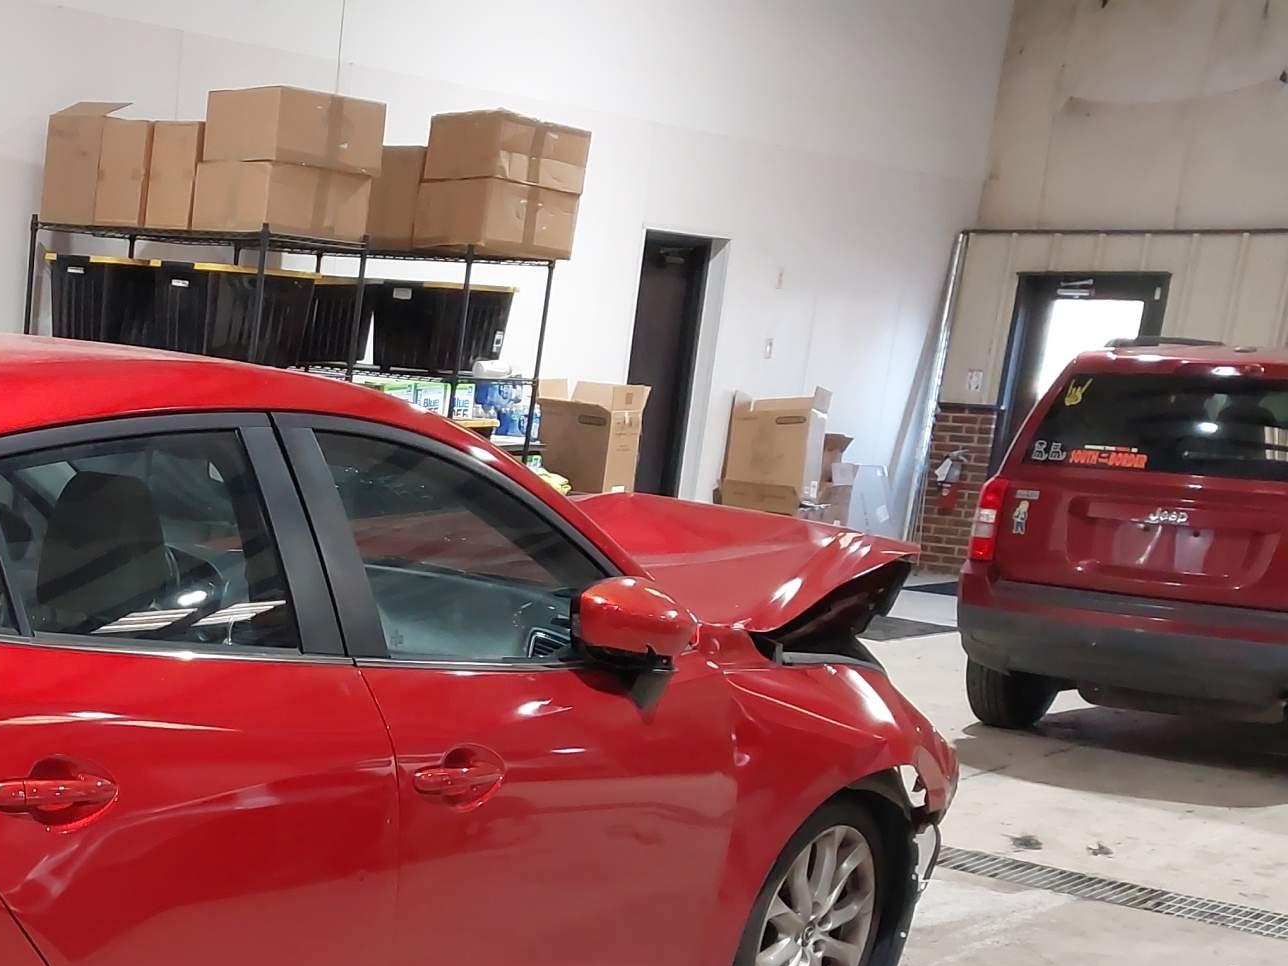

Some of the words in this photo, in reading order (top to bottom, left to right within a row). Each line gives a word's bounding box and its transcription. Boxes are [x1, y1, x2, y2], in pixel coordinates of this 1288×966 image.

[423, 397, 440, 408] Blue
[454, 397, 470, 408] lue
[1148, 507, 1189, 523] Jeep
